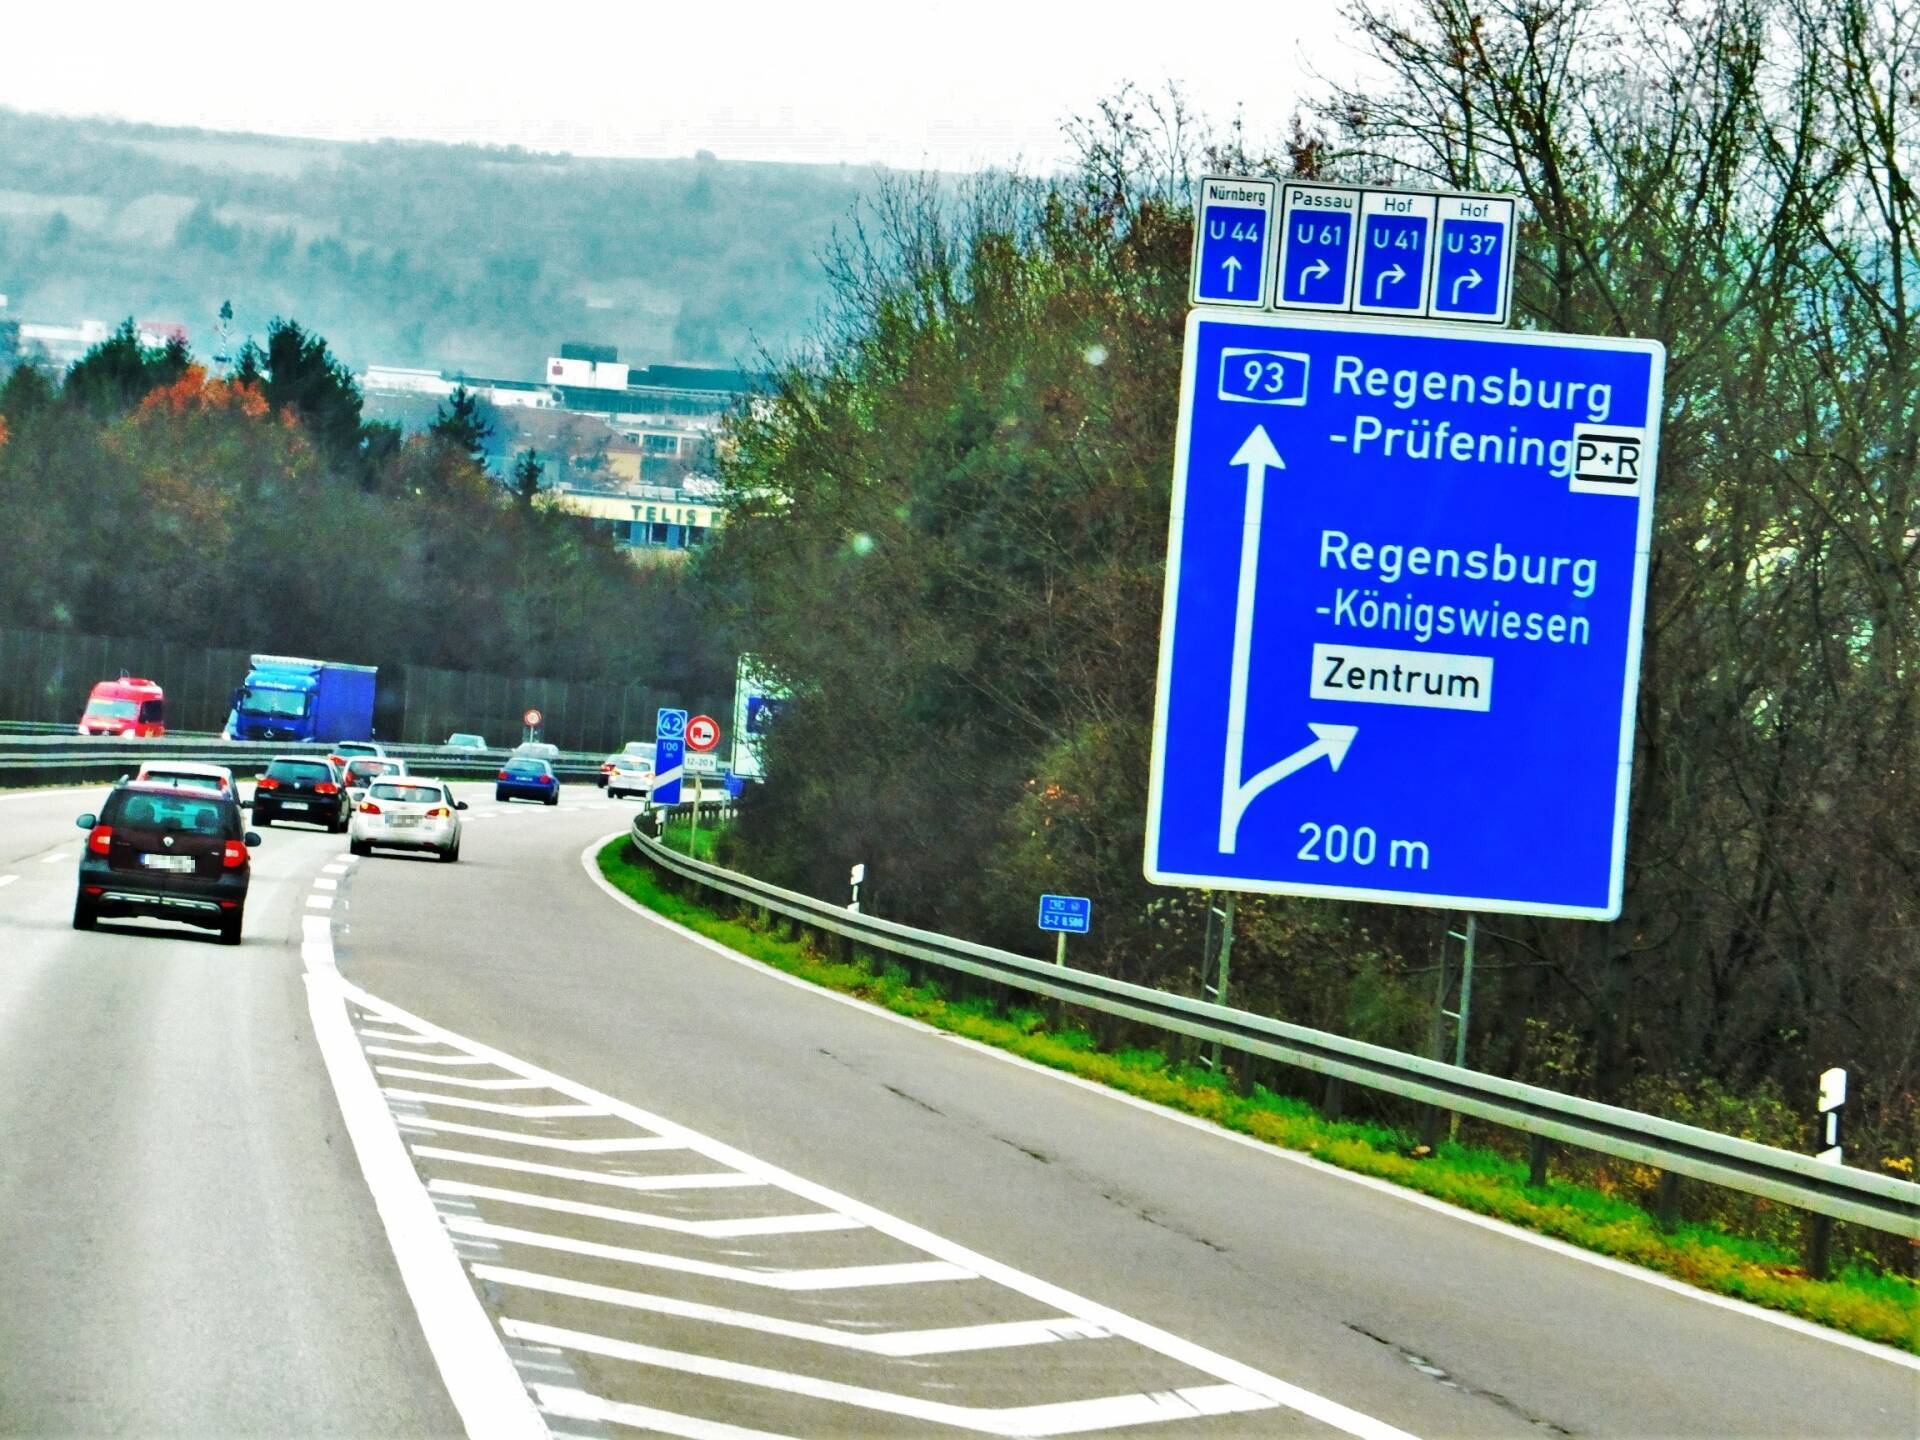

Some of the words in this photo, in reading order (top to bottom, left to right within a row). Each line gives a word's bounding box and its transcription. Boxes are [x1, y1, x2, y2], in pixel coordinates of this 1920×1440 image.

[1209, 185, 1266, 206] Nürnberg
[1292, 191, 1353, 210] Passau
[1384, 197, 1413, 213] Hof
[1459, 202, 1489, 218] Hof
[1210, 221, 1226, 240] U
[1230, 223, 1259, 243] 44
[1298, 224, 1313, 243] U
[1319, 225, 1342, 246] 61
[1373, 229, 1389, 249] U
[1394, 231, 1419, 251] 41
[1447, 234, 1464, 254] U
[1469, 235, 1497, 256] 37
[1243, 361, 1284, 393] 93
[1333, 356, 1612, 421] Regensburg
[1329, 416, 1573, 477] -Prüfening
[1576, 441, 1640, 476] P+R
[631, 504, 696, 525] TELIS
[1319, 530, 1597, 597] Regensburg
[1315, 588, 1590, 645] -Königswiesen
[1323, 656, 1480, 699] Zentrum
[662, 717, 681, 731] 42
[662, 742, 678, 751] 100
[1297, 822, 1377, 866] 200
[1389, 838, 1430, 870] m
